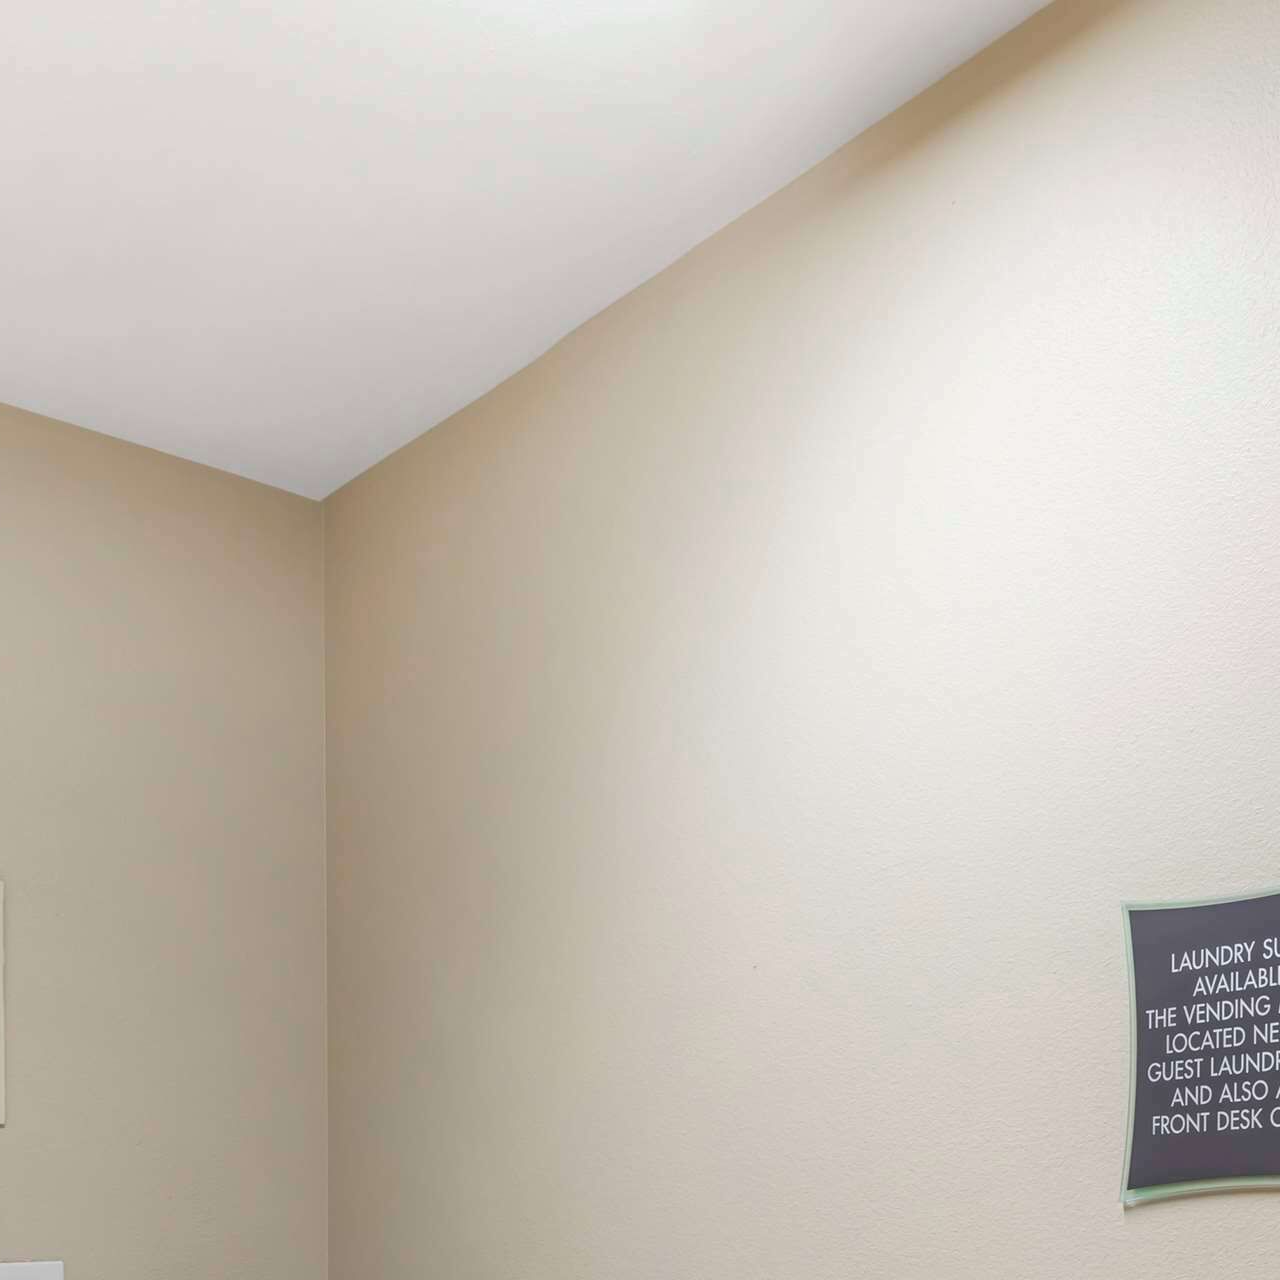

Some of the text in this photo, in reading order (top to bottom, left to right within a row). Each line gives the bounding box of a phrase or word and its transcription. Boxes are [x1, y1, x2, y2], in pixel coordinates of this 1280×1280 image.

[1171, 940, 1256, 973] LAUNDRY
[1145, 1006, 1177, 1030] THE
[1183, 995, 1271, 1025] VENDING
[1166, 1026, 1246, 1054] LOCATED
[1147, 1057, 1204, 1083] GUEST
[1170, 1085, 1213, 1107] AND
[1218, 1079, 1269, 1104] ALSO
[1152, 1111, 1211, 1136] FRONT
[1217, 1107, 1263, 1131] DESK
